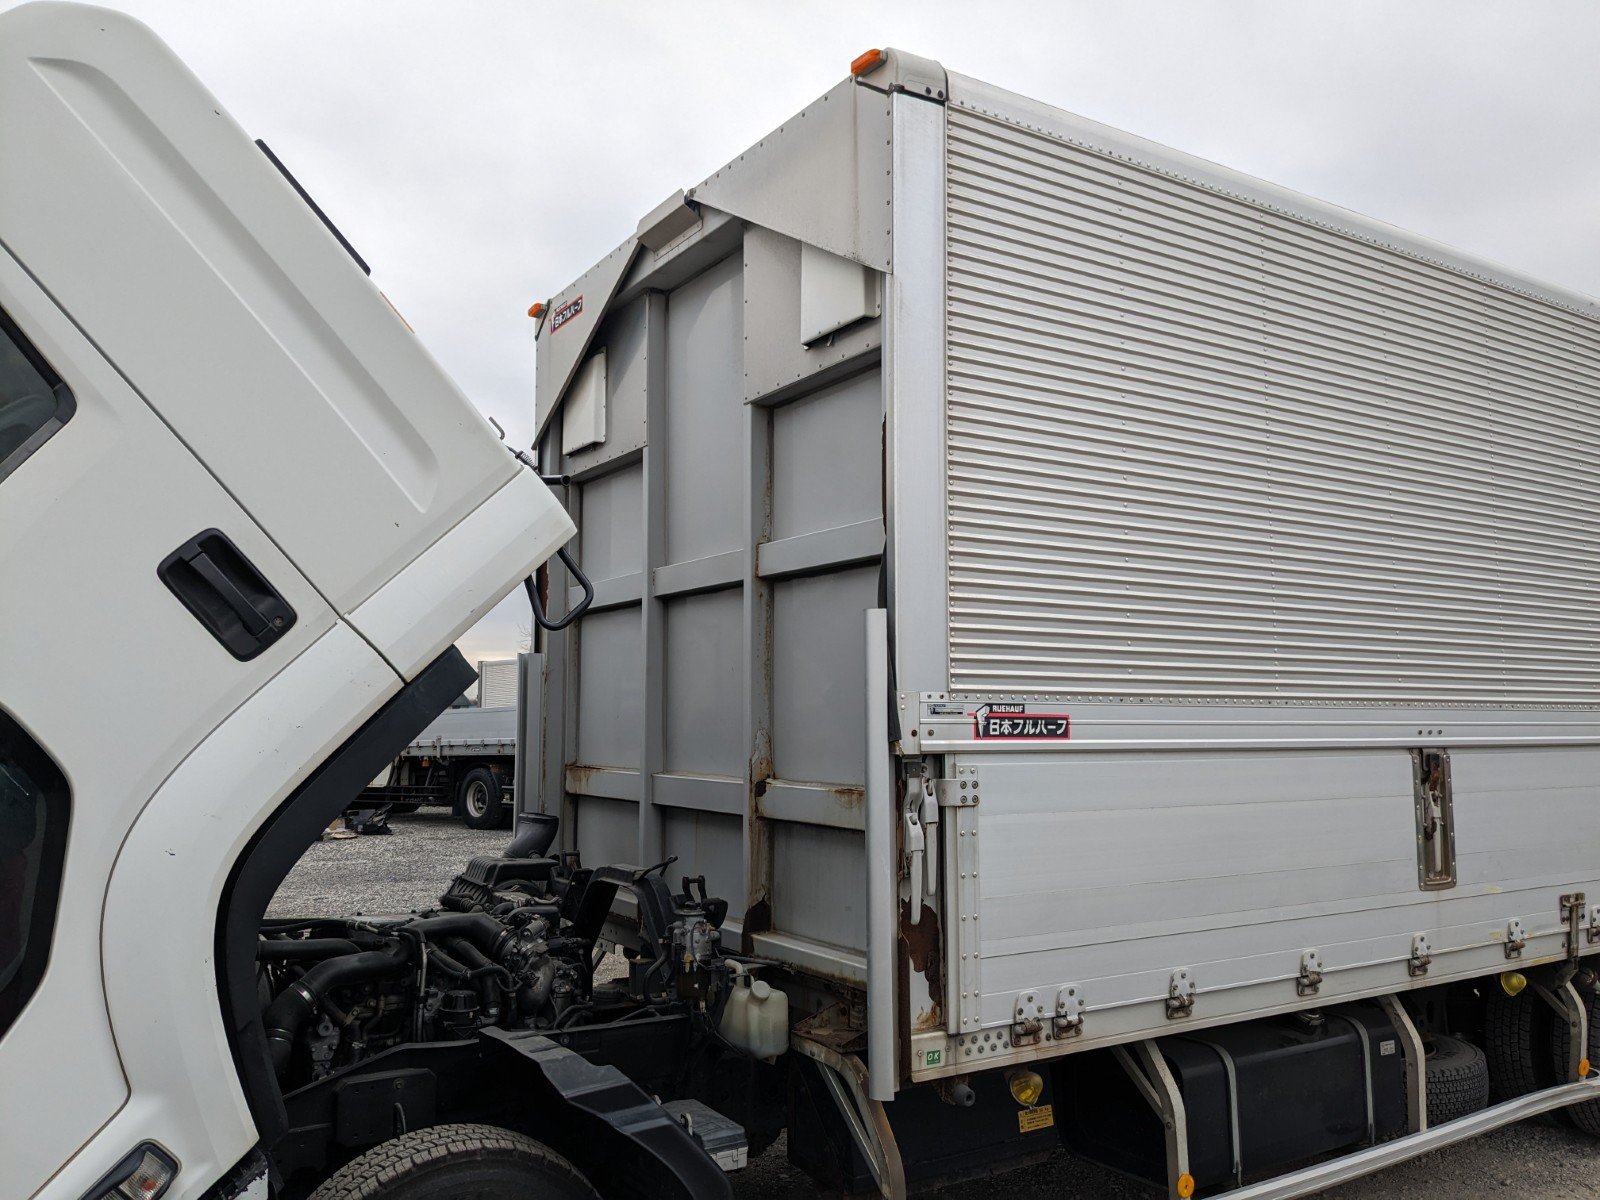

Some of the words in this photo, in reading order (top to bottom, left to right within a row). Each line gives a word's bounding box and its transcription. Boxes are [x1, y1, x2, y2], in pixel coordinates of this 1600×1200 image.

[989, 718, 1067, 736] 日本フルハーフ
[927, 1051, 940, 1061] OK
